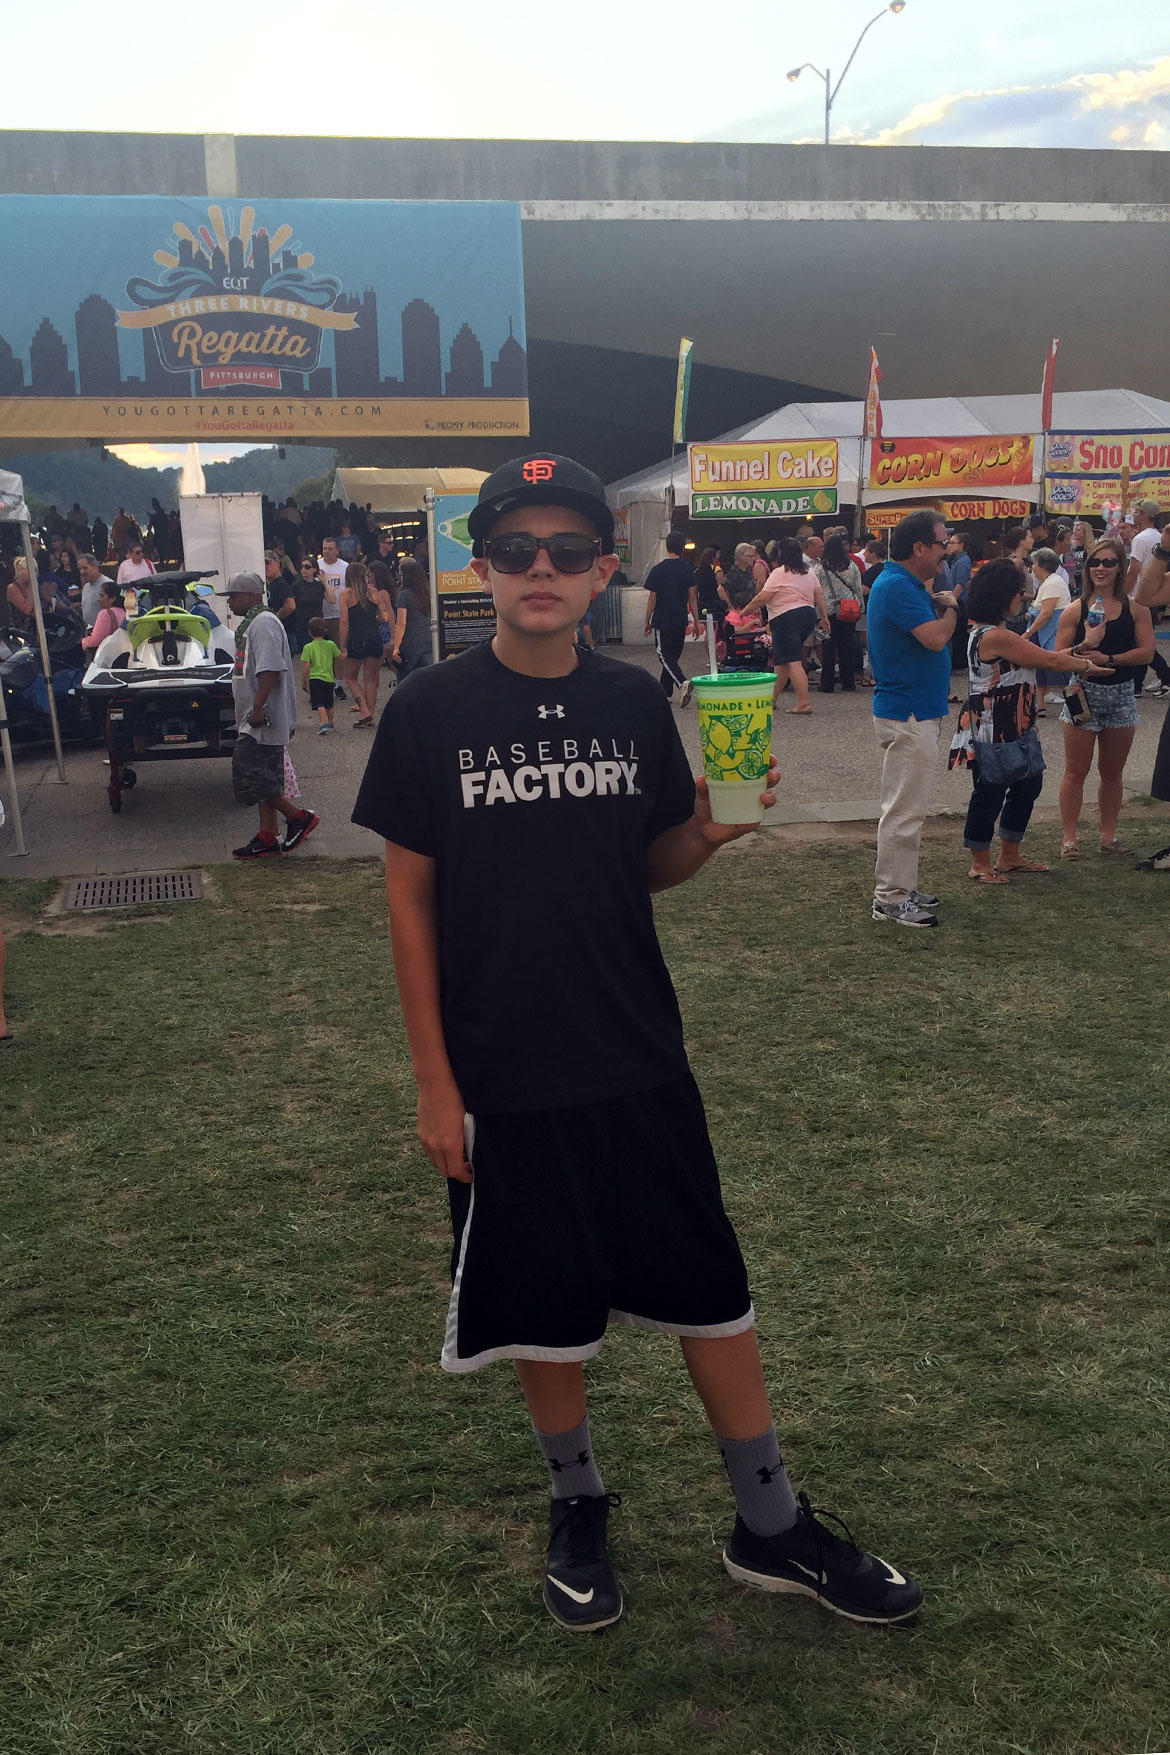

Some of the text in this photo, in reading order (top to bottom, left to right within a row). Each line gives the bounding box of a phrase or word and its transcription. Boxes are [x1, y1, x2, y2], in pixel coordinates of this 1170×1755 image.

[222, 277, 250, 290] EQT
[166, 297, 309, 319] THREE RIVERS
[171, 320, 311, 365] Regatta
[210, 371, 274, 380] PITTSBURGH
[103, 405, 382, 417] YOUGOTTAREGATTA.COM
[194, 419, 295, 433] #YouGottaRegatta
[436, 421, 519, 429] PEONY PRODUCTION
[876, 450, 943, 485] CORN
[950, 438, 1014, 473] DOGS
[1079, 439, 1123, 471] Sno
[693, 450, 835, 484] Funnel Cake
[695, 495, 811, 514] LEMONADE
[951, 500, 1026, 518] CORN DOGS
[442, 577, 482, 586] POINT STA
[444, 608, 495, 619] Point State Park
[458, 738, 639, 770] BASEBALL
